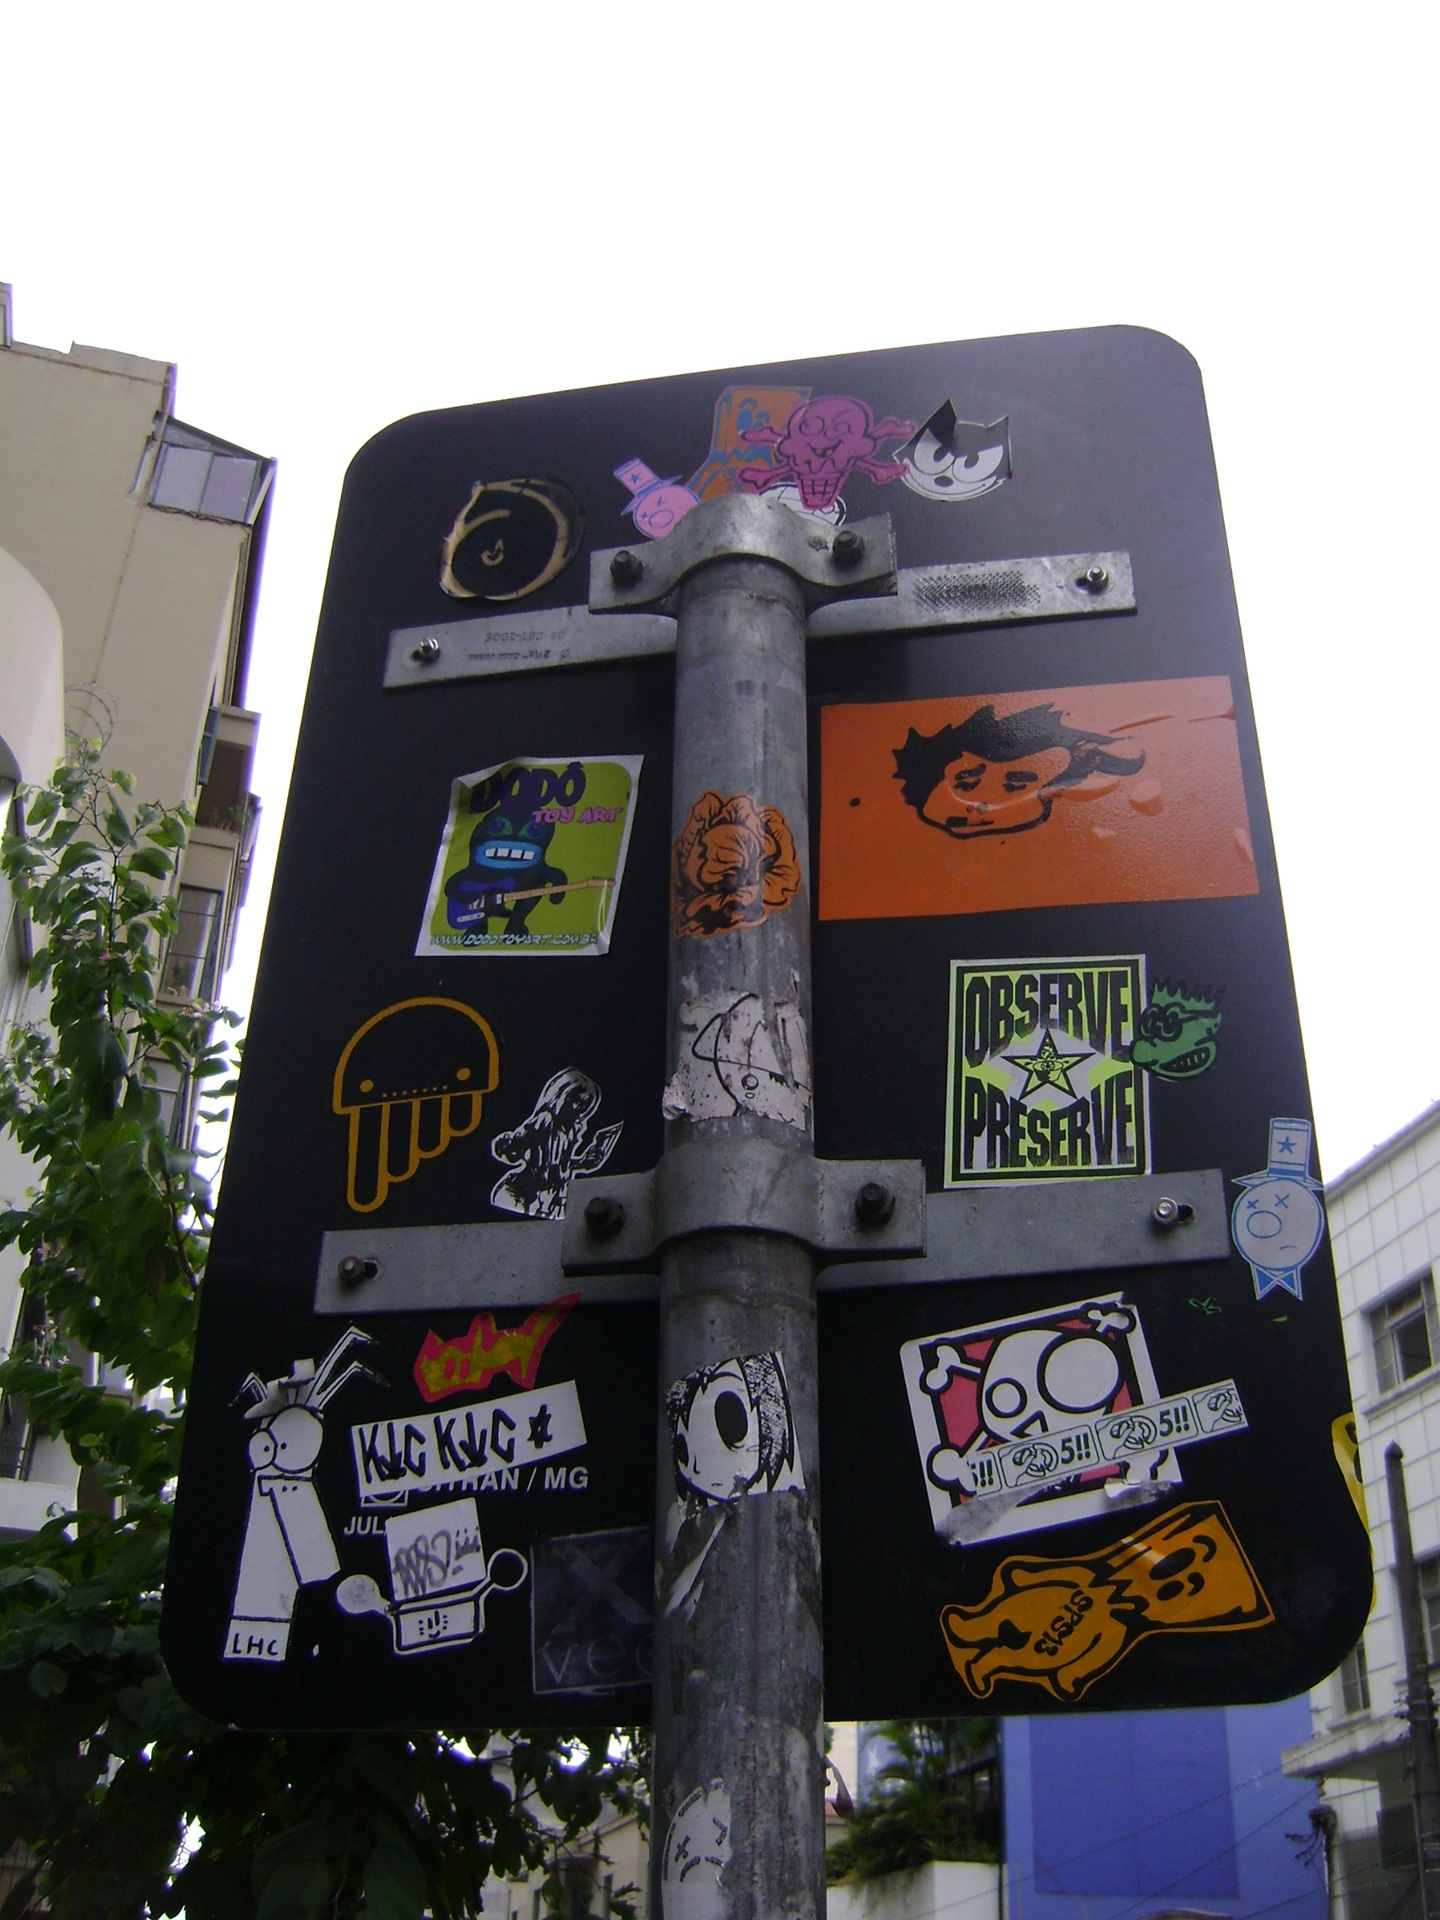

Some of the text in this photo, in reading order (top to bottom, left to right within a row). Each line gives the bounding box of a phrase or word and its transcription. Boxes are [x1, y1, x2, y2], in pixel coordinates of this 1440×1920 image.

[532, 806, 622, 824] TOY ART
[964, 970, 1131, 1068] OBSERVE
[963, 1070, 1135, 1170] PRESERVE
[1061, 1432, 1091, 1465] 5!!
[1159, 1404, 1190, 1438] 5!!
[544, 1467, 589, 1490] MG
[232, 1632, 279, 1657] LHC
